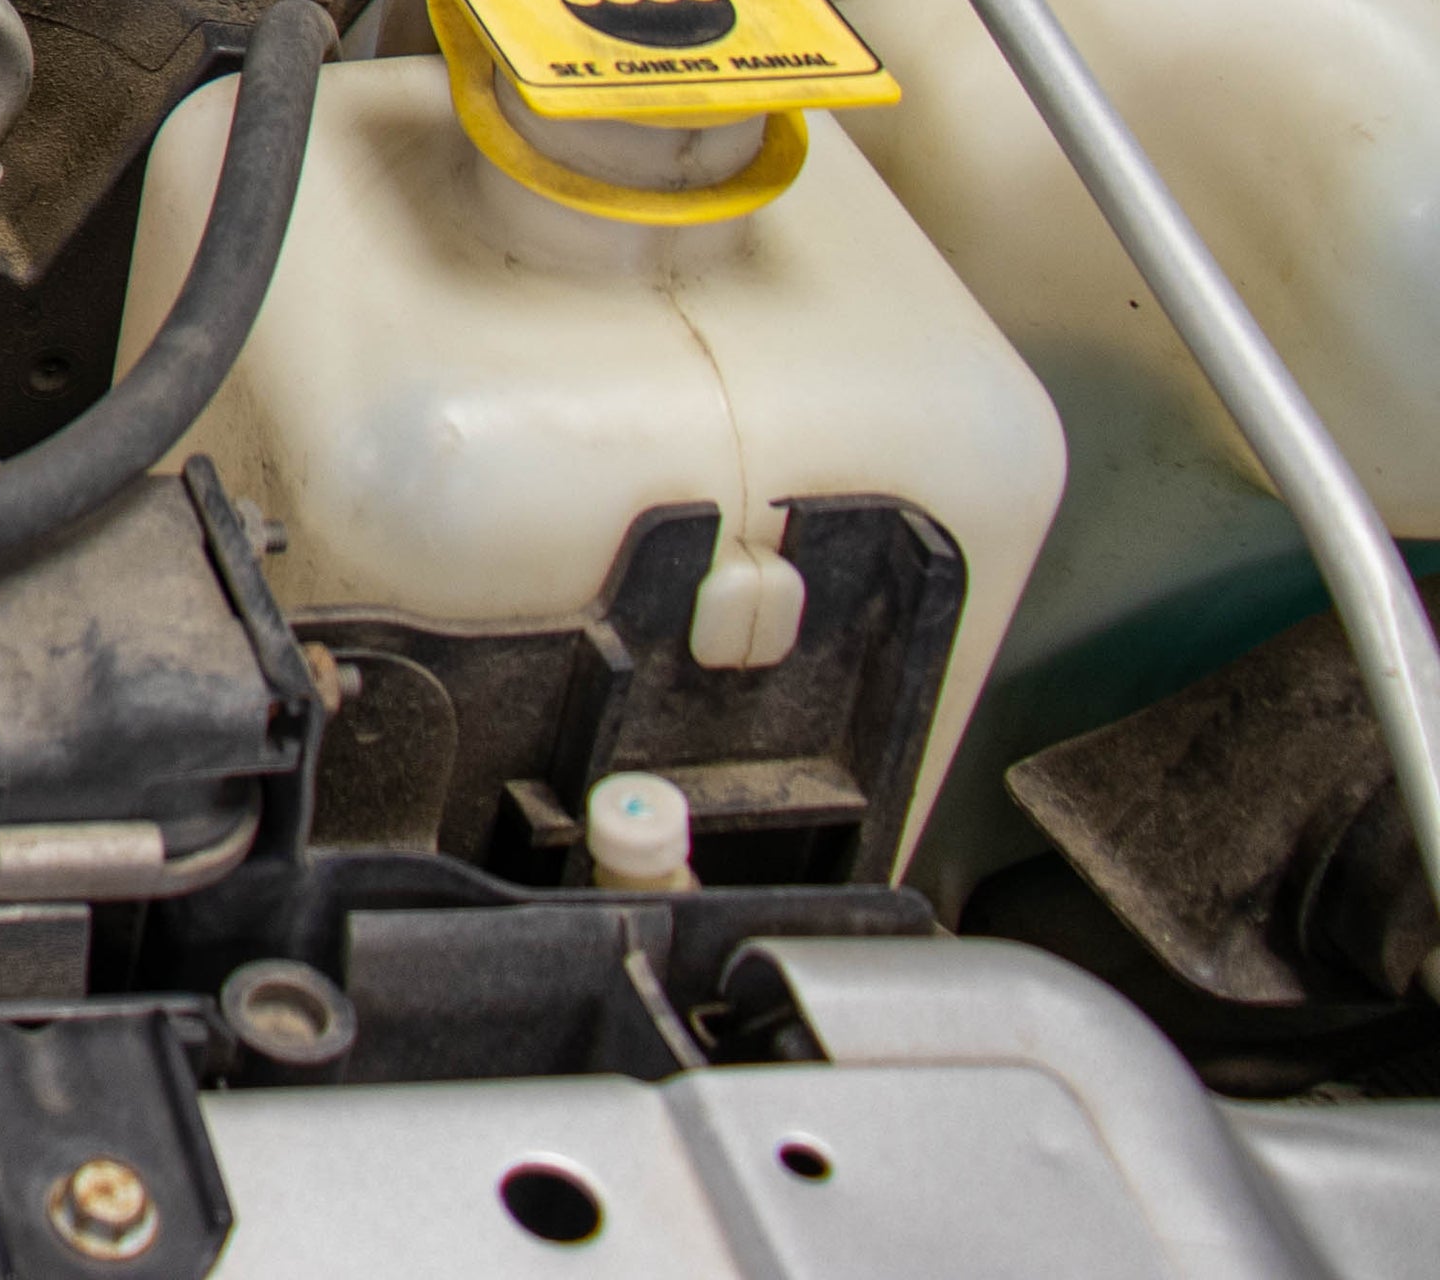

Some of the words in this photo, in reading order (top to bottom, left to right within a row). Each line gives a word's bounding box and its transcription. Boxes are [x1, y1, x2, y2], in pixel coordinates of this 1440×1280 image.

[549, 62, 603, 79] SEE
[615, 56, 720, 76] OWNERS
[730, 52, 838, 71] MANUAL
